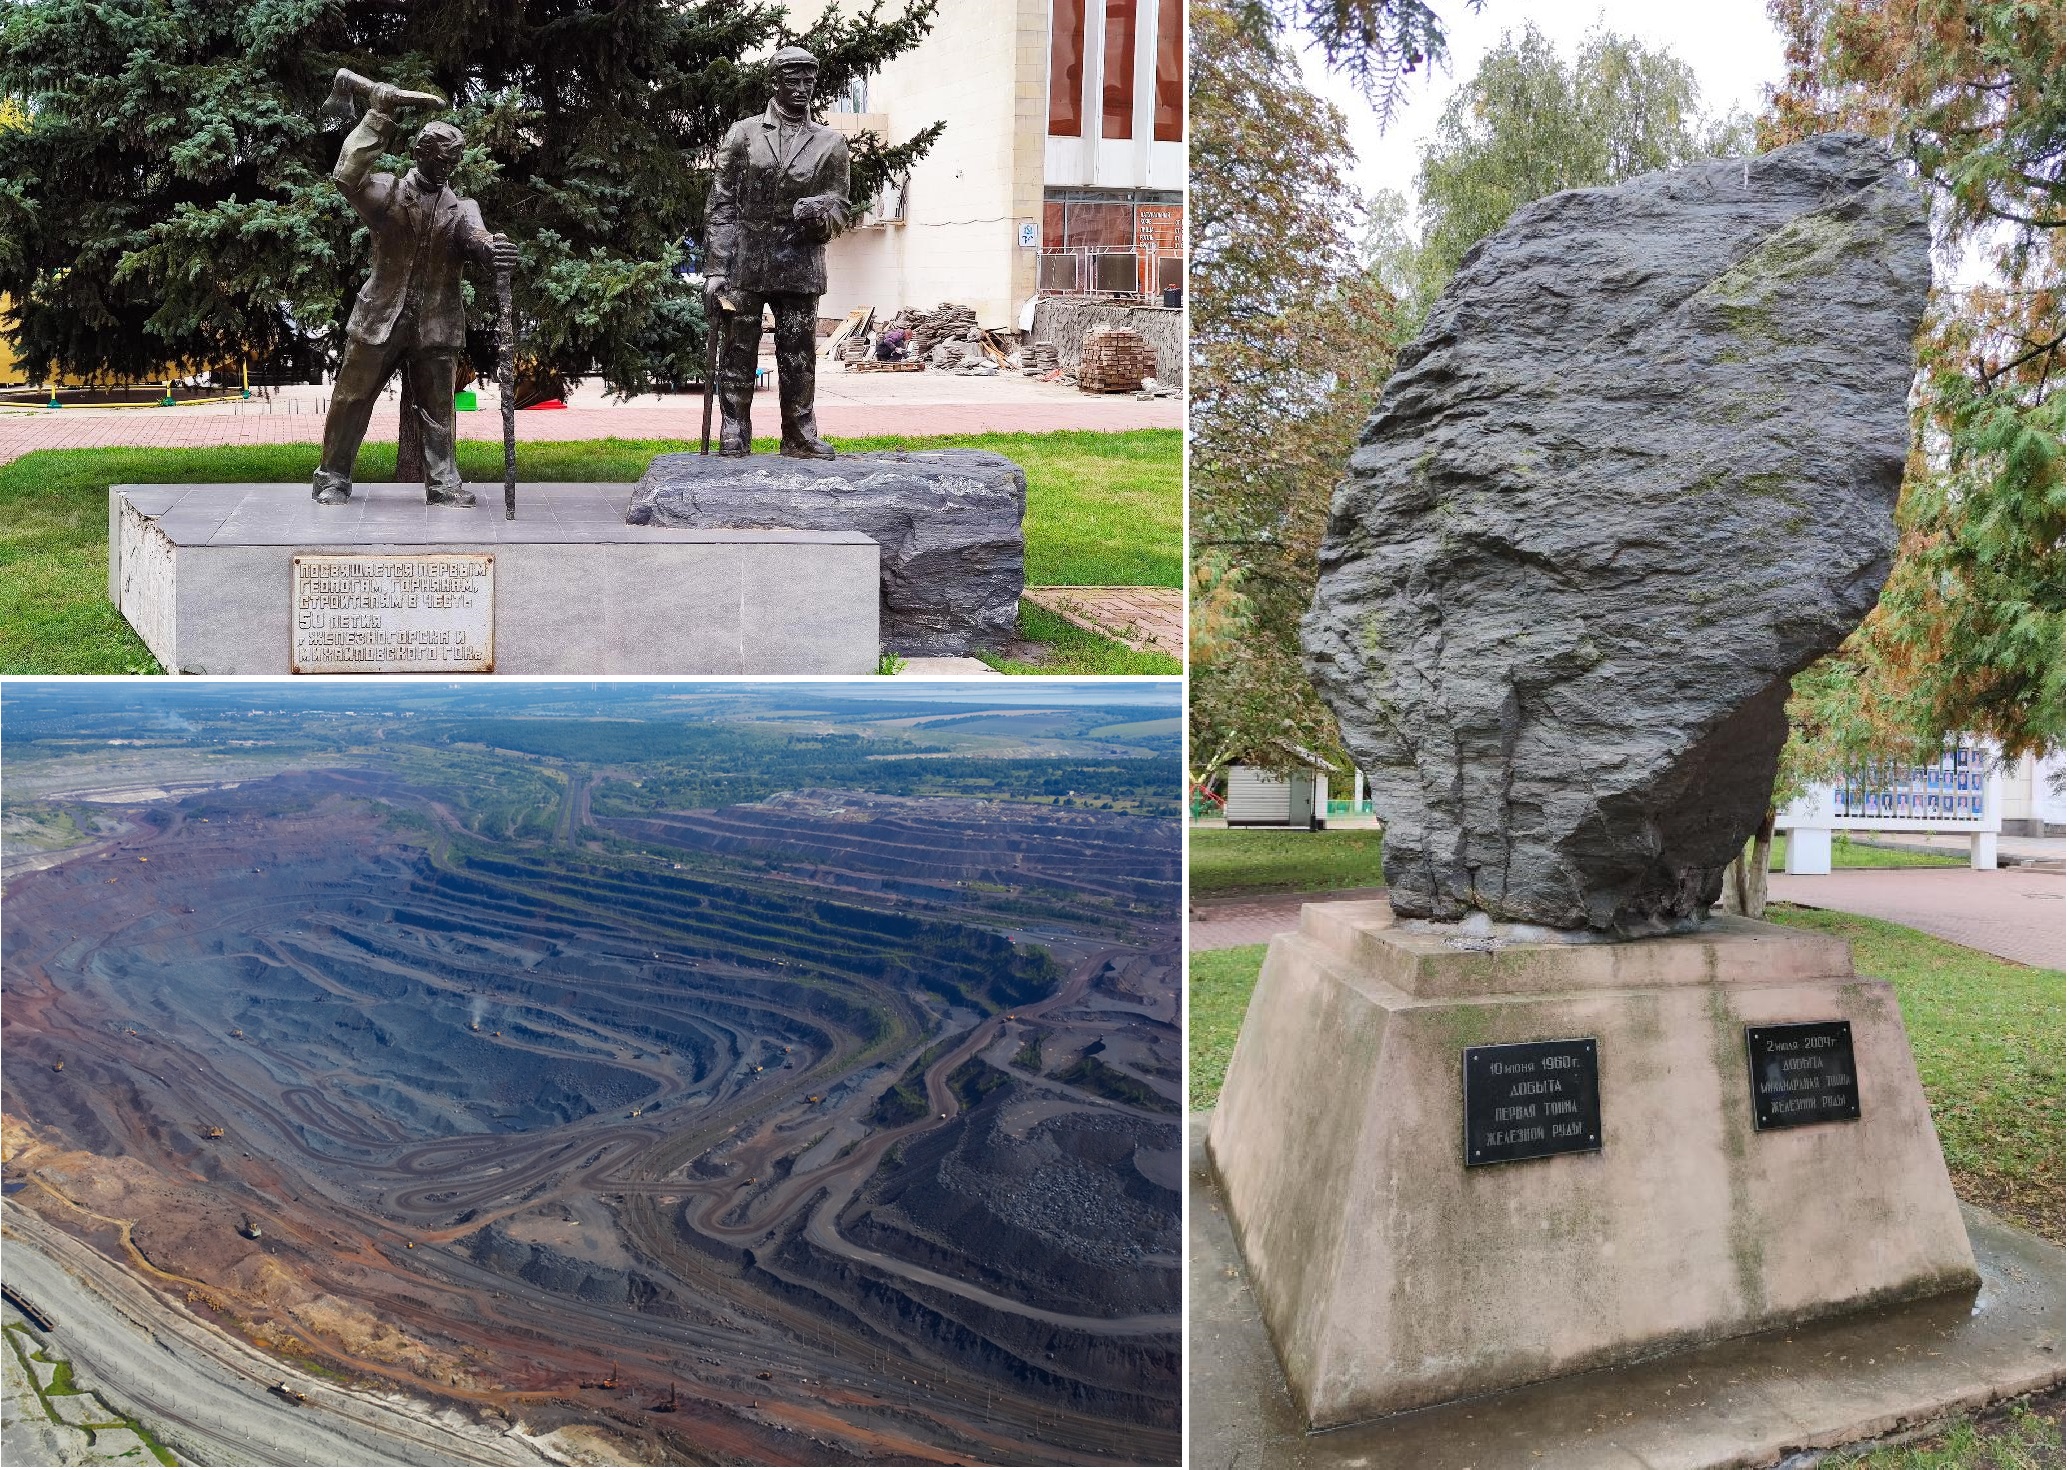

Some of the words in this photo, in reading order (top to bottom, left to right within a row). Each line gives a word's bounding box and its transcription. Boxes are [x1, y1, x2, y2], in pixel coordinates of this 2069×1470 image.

[418, 563, 486, 577] ПЕРВЫМ
[299, 594, 402, 610] СТРОИТЕЛЯМ
[407, 594, 418, 609] В
[423, 594, 473, 609] ЧЕСТЬ
[299, 610, 325, 629] 50
[455, 630, 467, 645] И
[1509, 1080, 1563, 1097] ДОБЫТА
[1495, 1103, 1537, 1122] ПЕРВАЯ
[1486, 1126, 1545, 1146] ЖЕЛЕЗНОЙ
